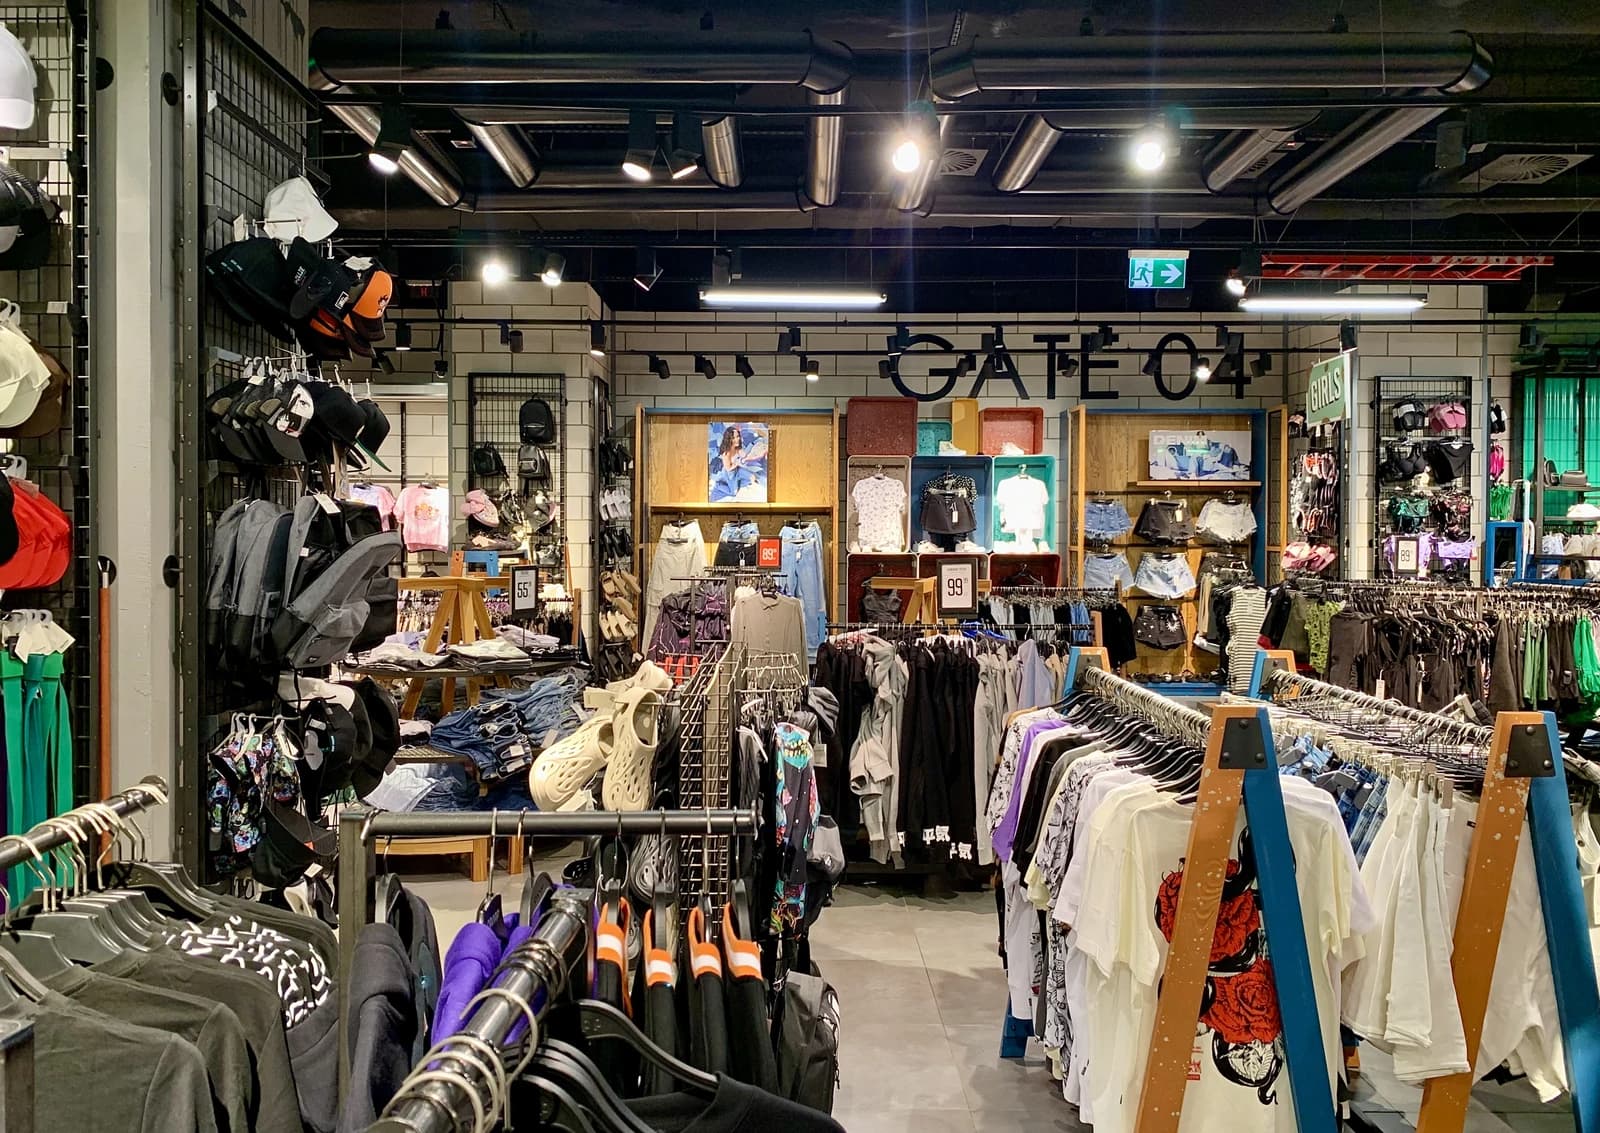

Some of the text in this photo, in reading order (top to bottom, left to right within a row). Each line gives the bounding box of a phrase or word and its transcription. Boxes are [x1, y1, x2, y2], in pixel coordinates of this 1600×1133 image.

[888, 332, 1252, 402] GATE 04
[1311, 367, 1341, 412] GIRLS
[517, 581, 529, 598] 55
[947, 578, 963, 597] 99
